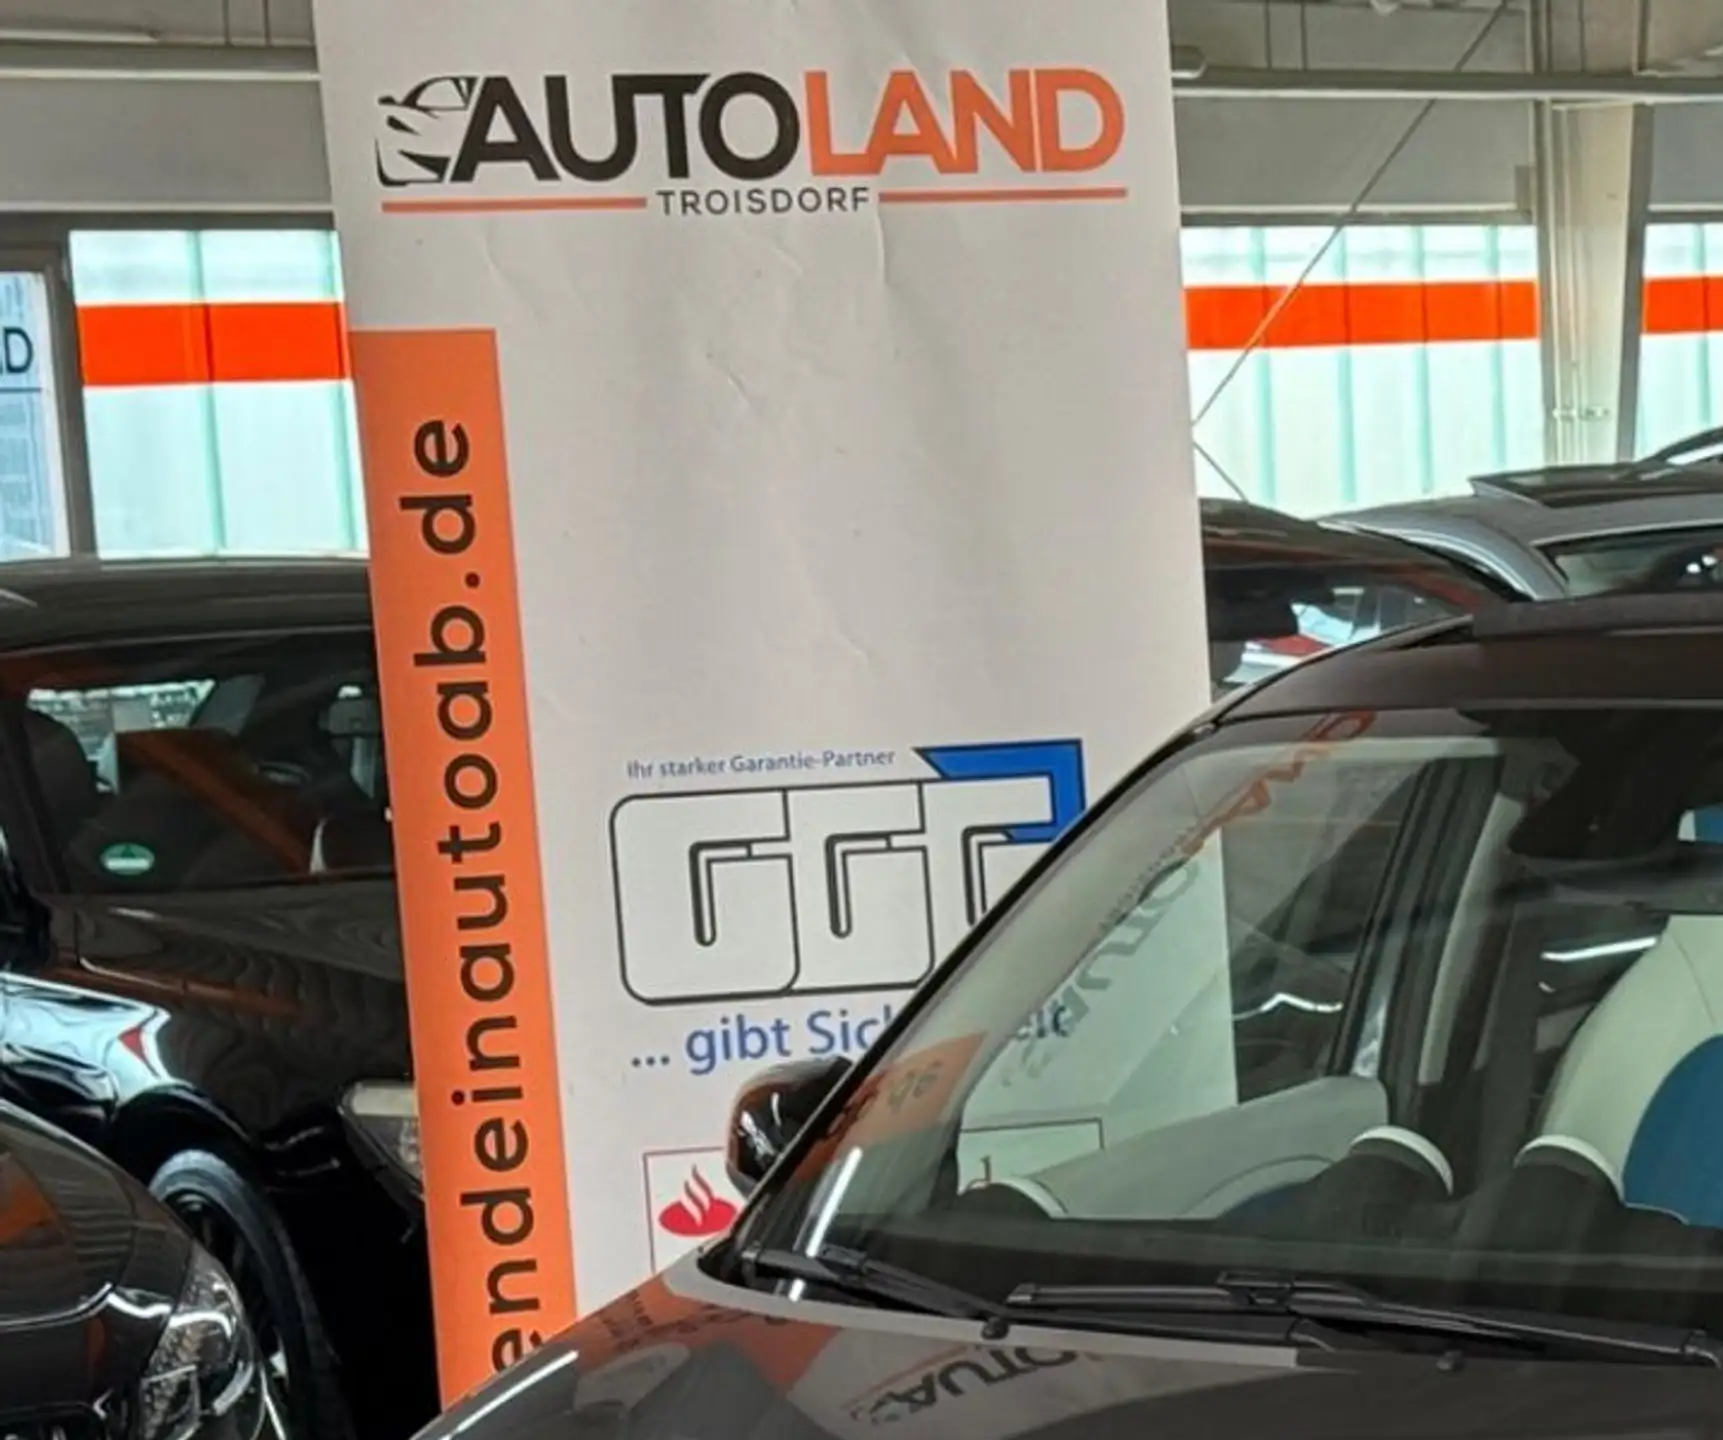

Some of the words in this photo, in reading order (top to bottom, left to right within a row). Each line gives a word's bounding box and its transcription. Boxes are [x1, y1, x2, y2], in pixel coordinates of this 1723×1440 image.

[451, 68, 1126, 183] AUTOLAND
[656, 186, 871, 217] TROISDORF
[626, 761, 653, 780] Ihr
[658, 756, 728, 778] starker
[729, 749, 895, 774] Garantie-Partner
[685, 1015, 792, 1076] gibt
